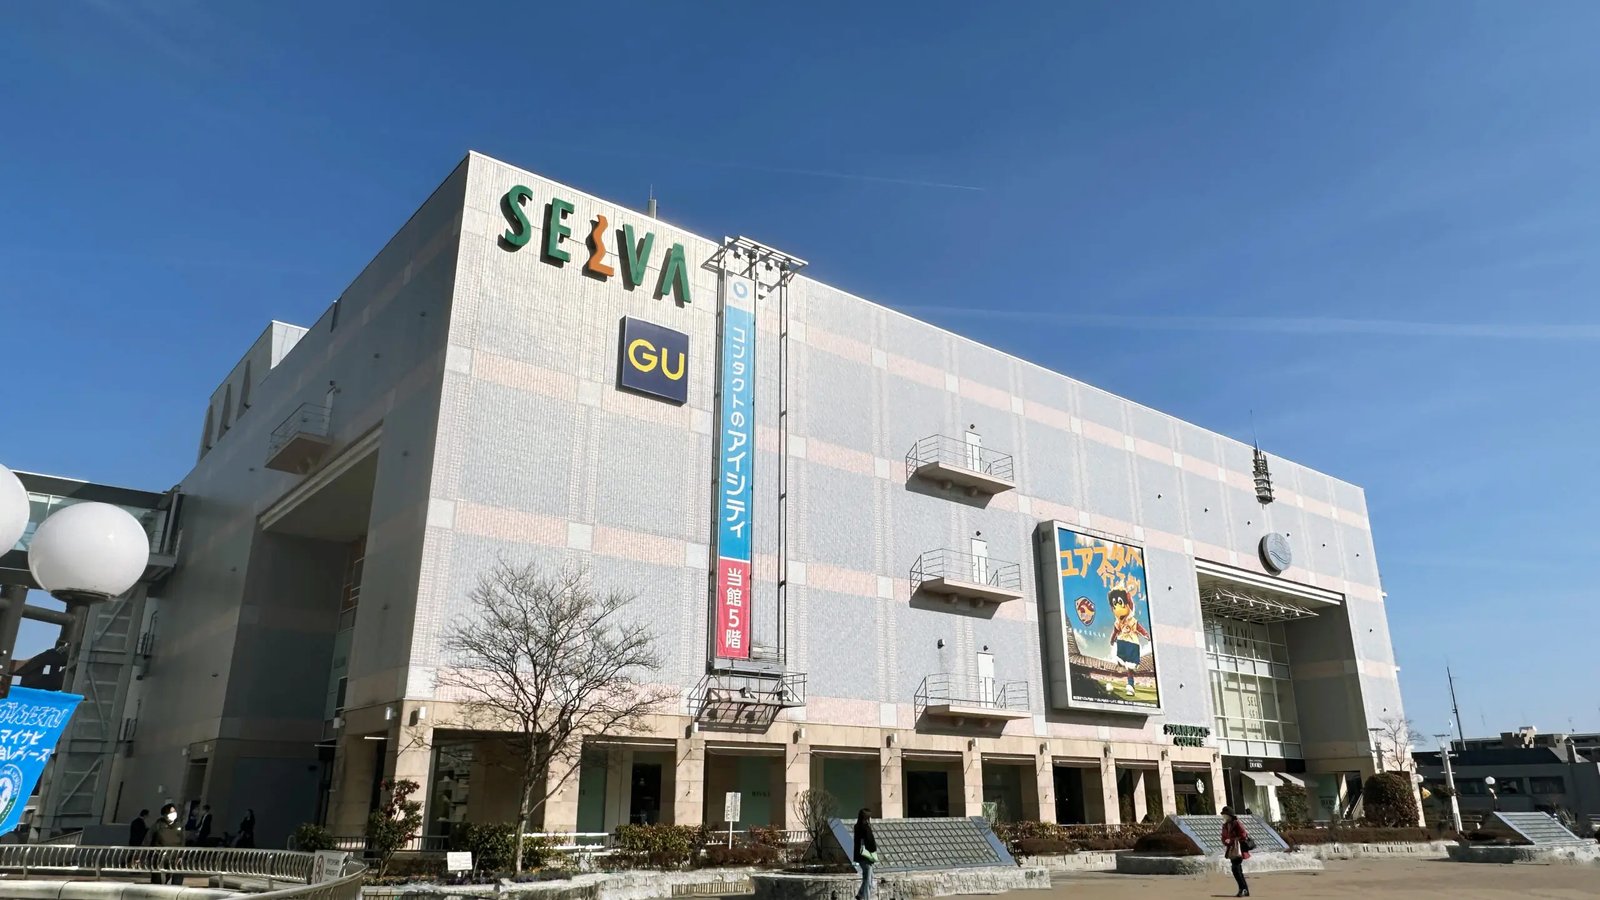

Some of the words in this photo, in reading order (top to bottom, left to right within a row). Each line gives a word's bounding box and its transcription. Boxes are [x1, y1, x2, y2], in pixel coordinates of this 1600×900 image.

[502, 184, 692, 303] SELVA
[628, 339, 685, 380] GU
[726, 326, 748, 538] コンタクトのアイシティ
[725, 567, 742, 649] 当館5階
[1, 729, 46, 745] マイナビ
